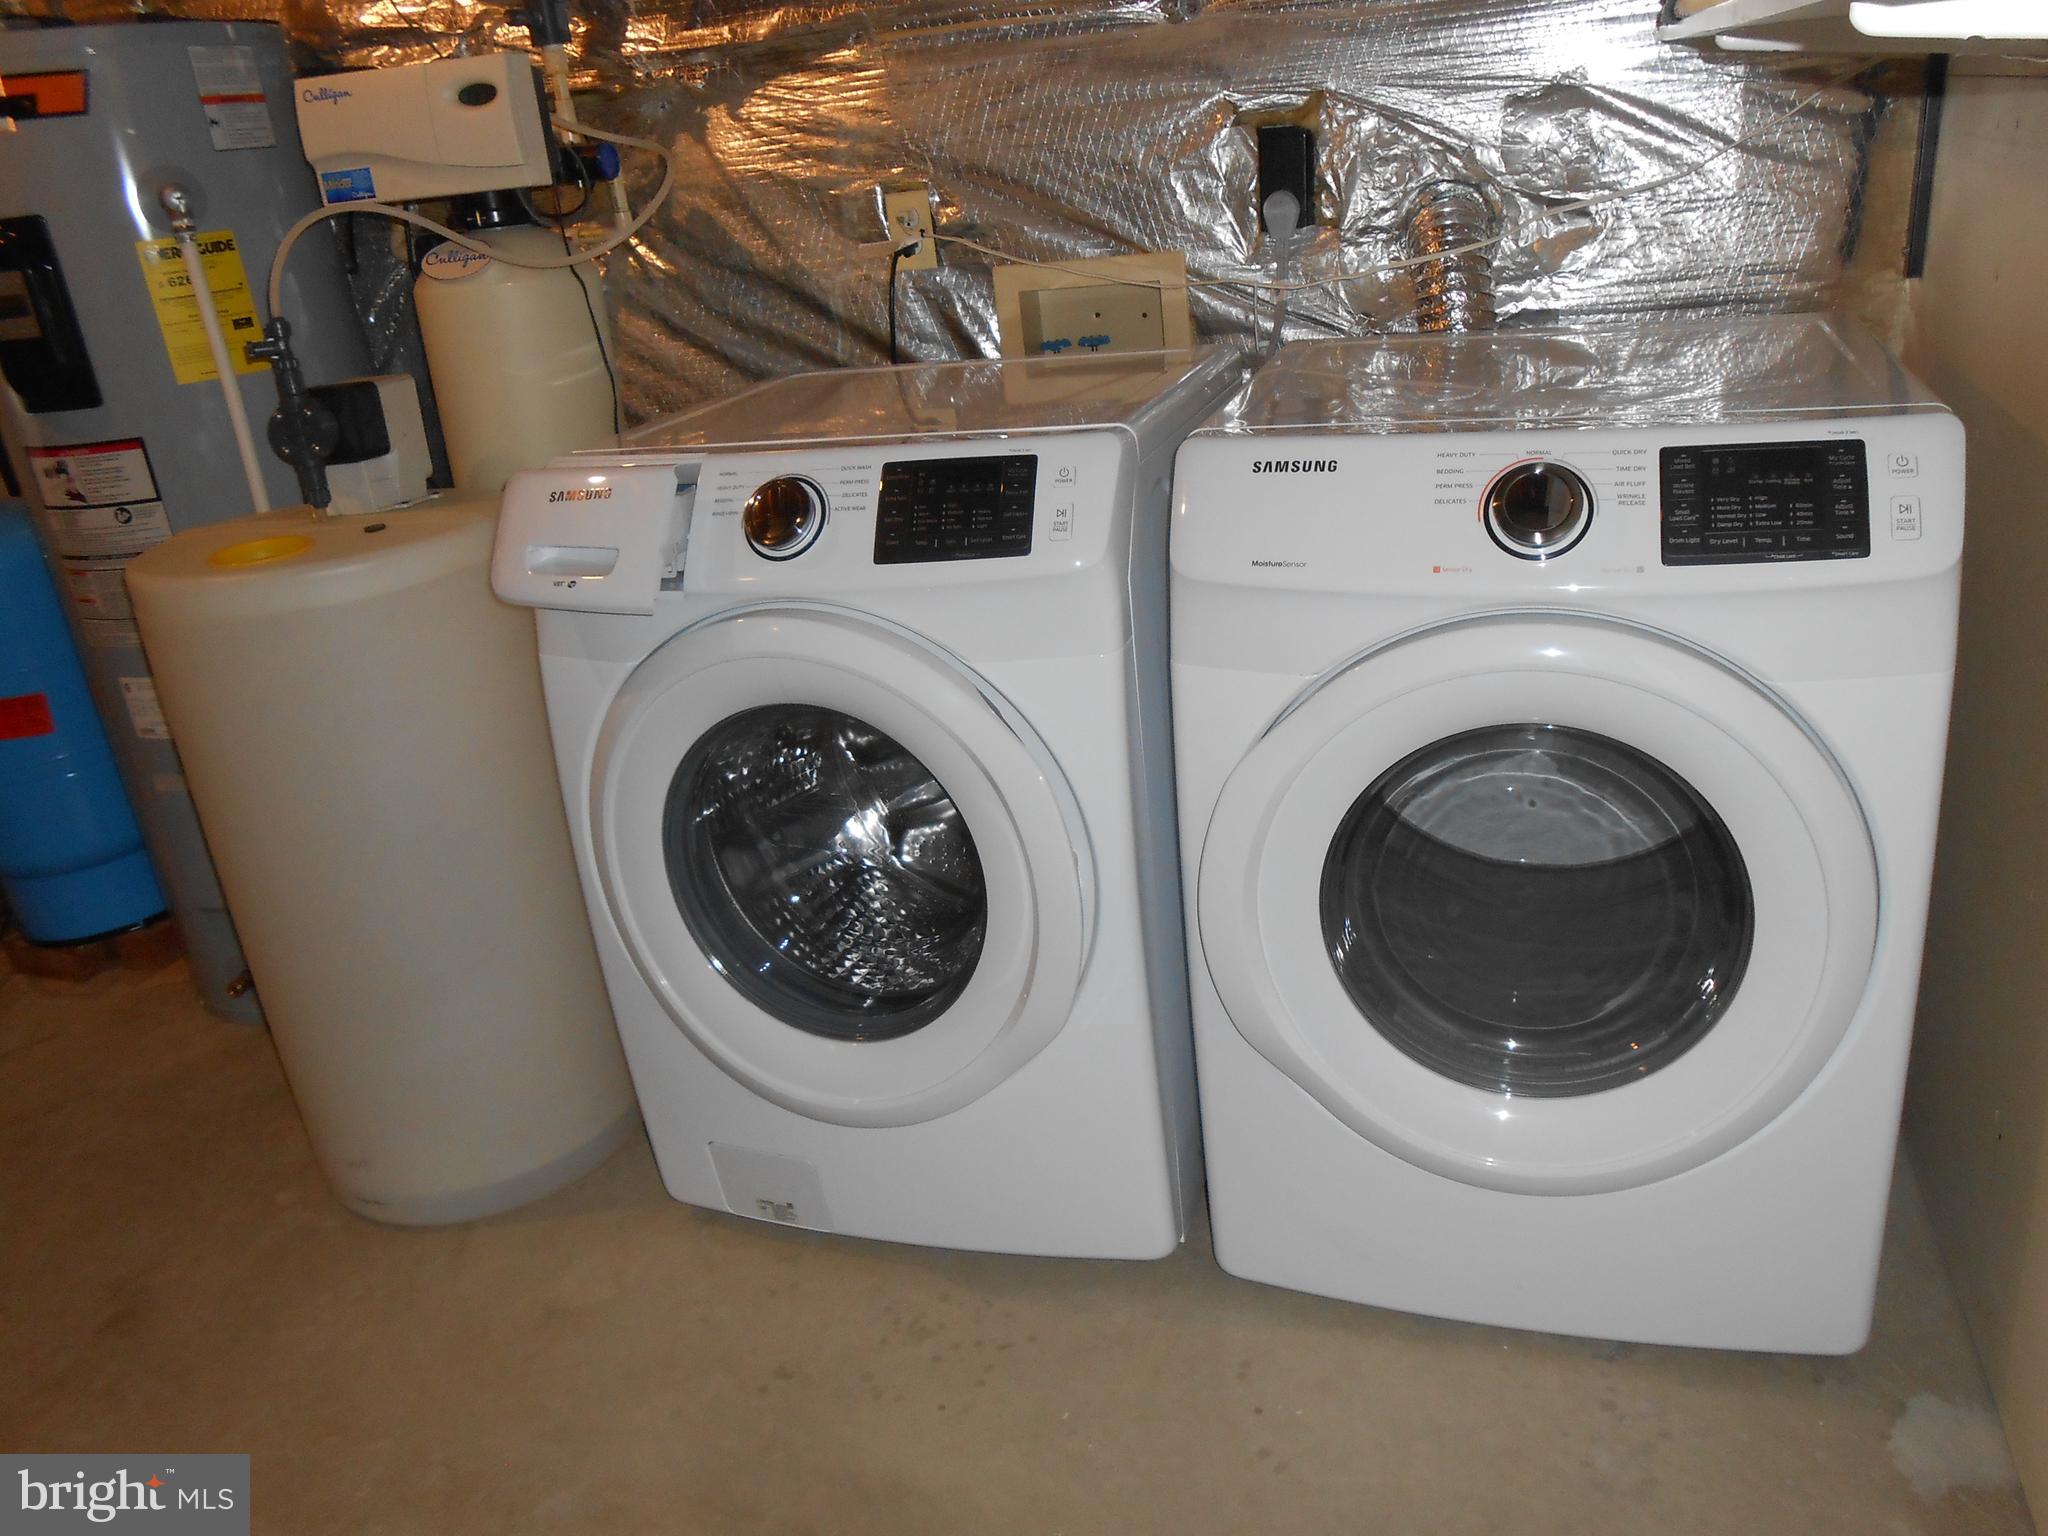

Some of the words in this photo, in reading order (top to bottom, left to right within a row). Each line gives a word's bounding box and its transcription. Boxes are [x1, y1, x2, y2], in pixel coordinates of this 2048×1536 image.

[303, 87, 352, 105] Culligan
[425, 250, 489, 270] Culligan
[1252, 459, 1339, 474] SAMSUNG
[549, 487, 612, 503] SAMSUNG
[1251, 560, 1307, 568] MoistureSensor
